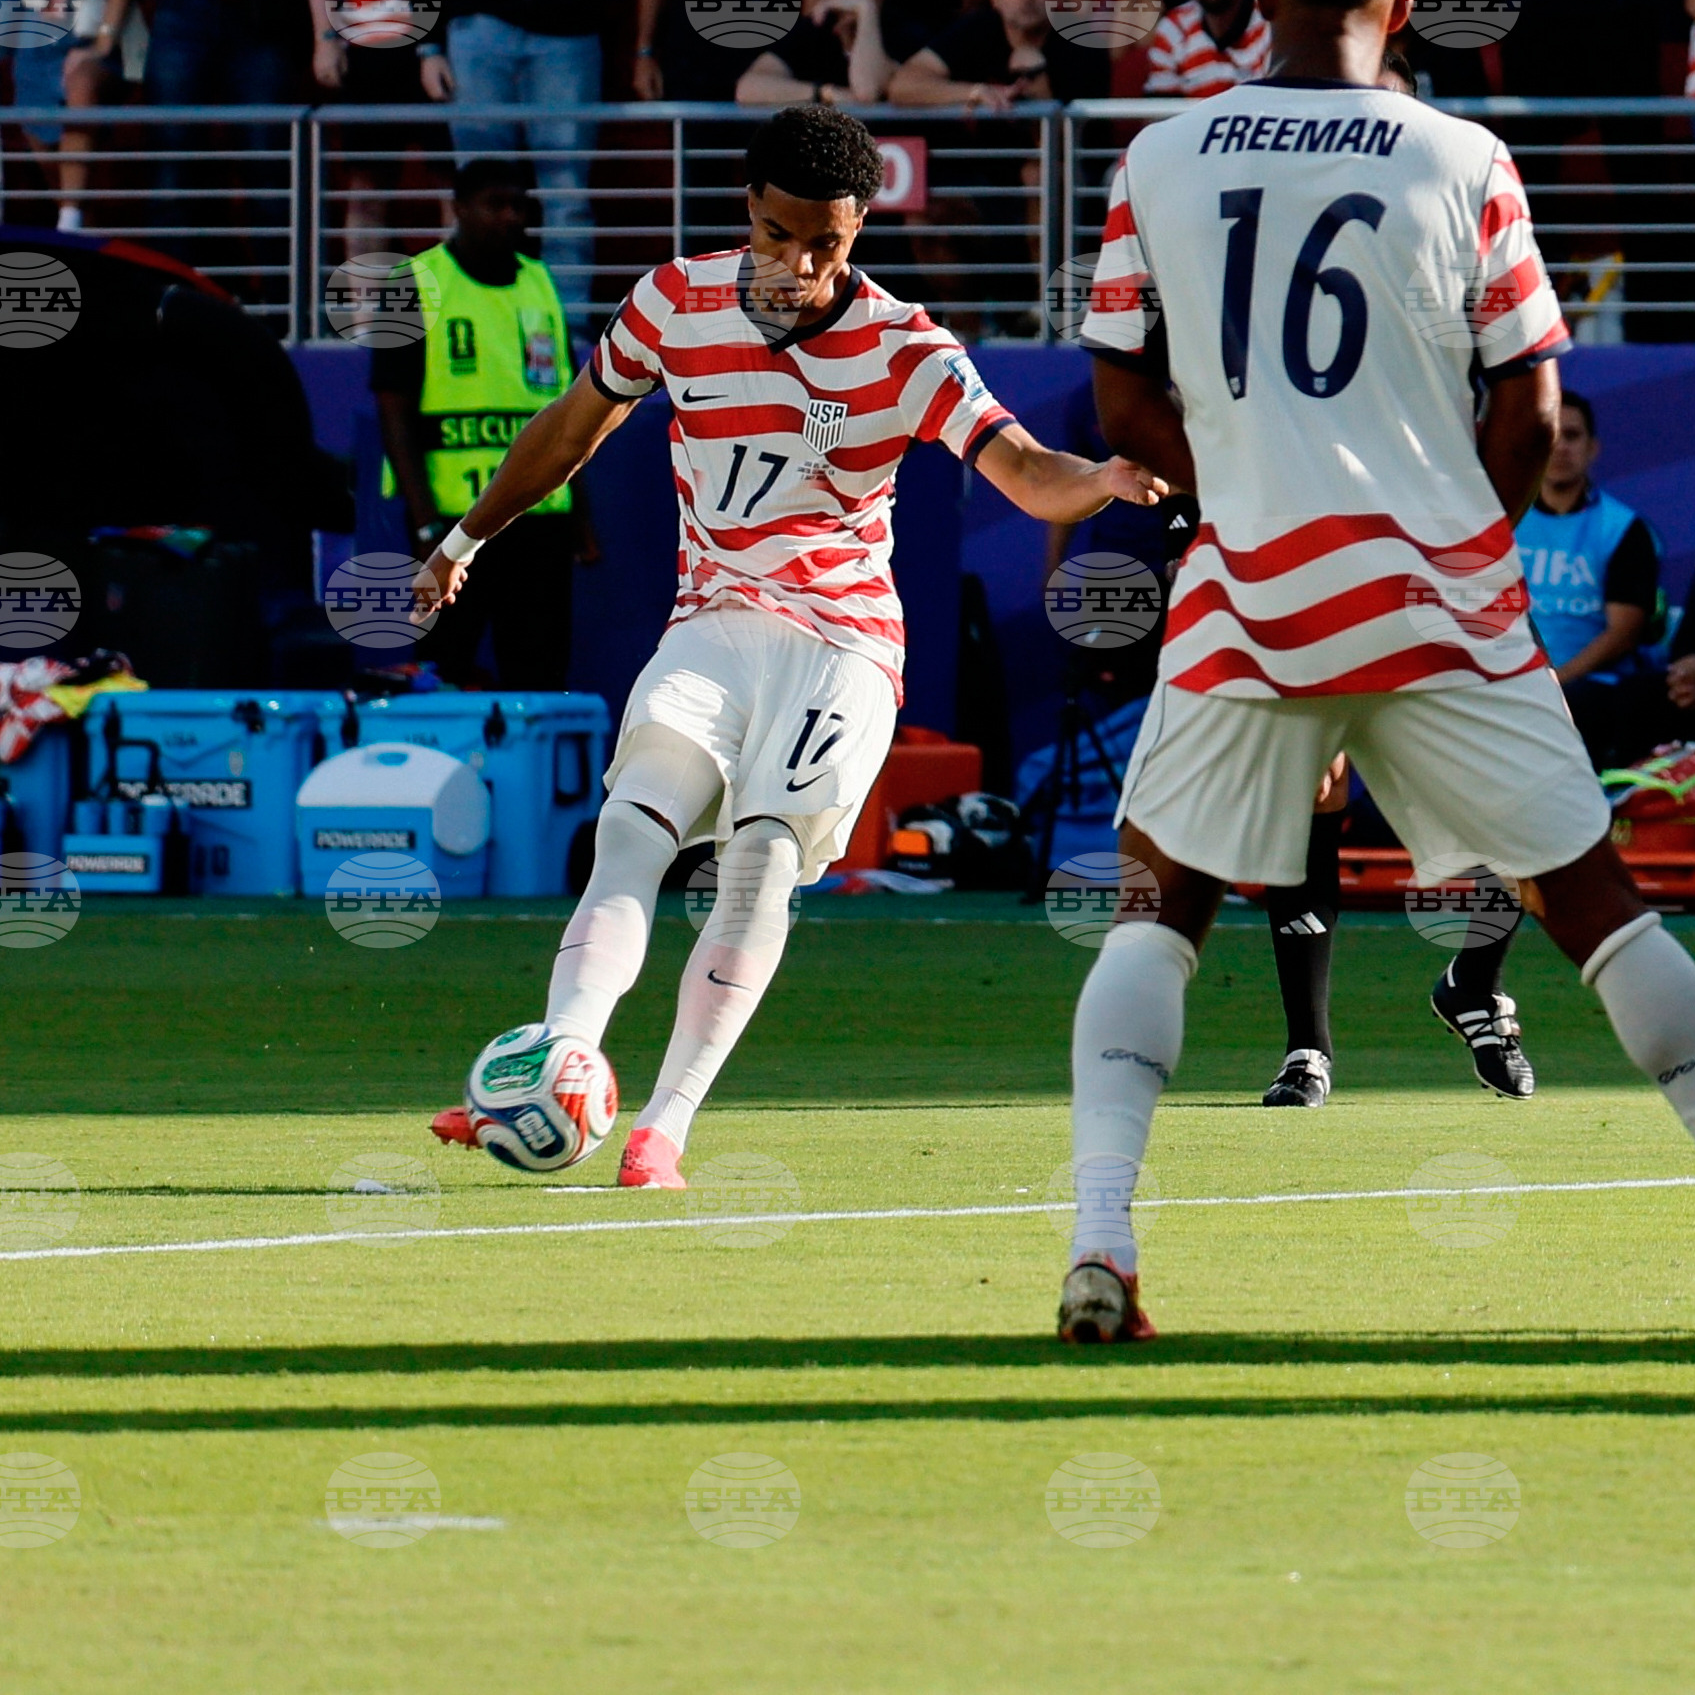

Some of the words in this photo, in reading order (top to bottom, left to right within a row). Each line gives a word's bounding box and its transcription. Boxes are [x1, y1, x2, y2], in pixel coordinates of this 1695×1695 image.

[1199, 115, 1404, 156] FREEMAN
[1219, 187, 1388, 401] 16
[440, 415, 534, 447] SECU
[809, 401, 845, 424] USA
[716, 443, 790, 519] 17
[784, 707, 847, 772] 17
